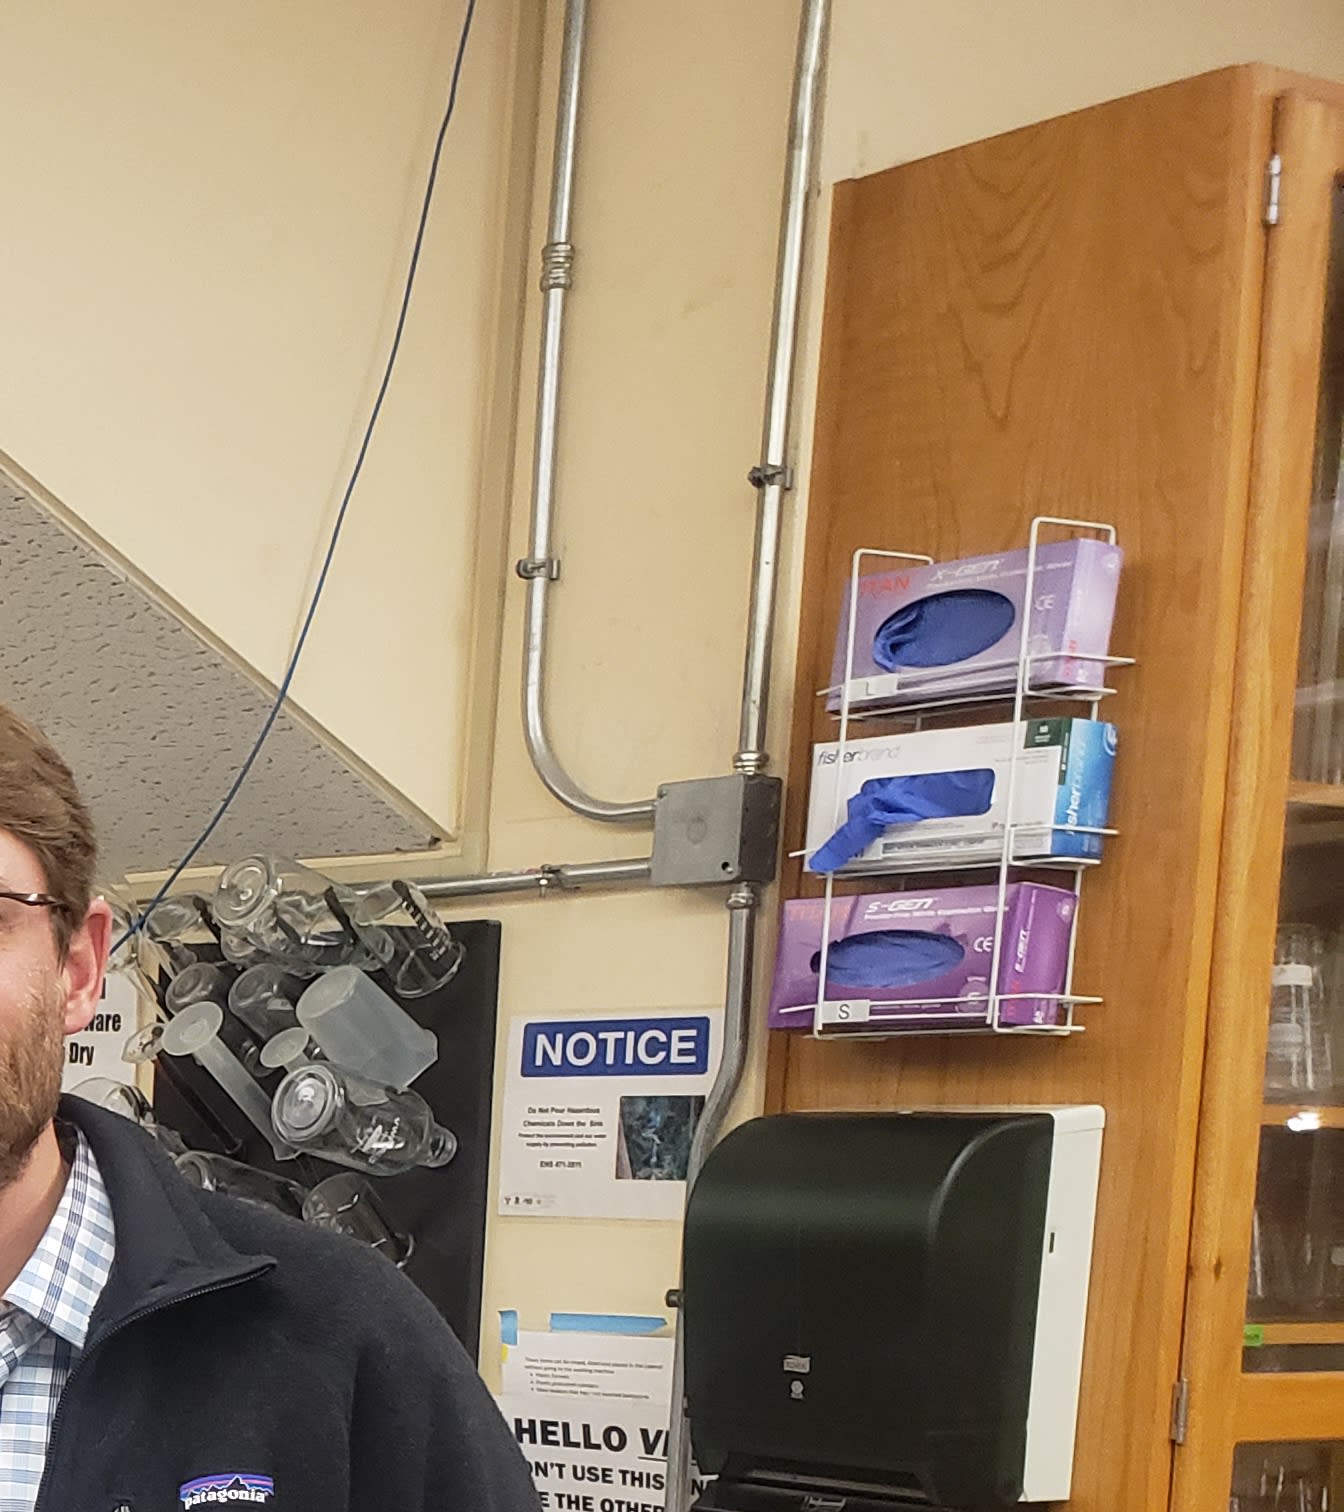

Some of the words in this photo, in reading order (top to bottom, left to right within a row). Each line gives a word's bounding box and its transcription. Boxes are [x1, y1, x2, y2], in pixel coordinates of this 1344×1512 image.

[838, 1004, 850, 1020] S
[69, 1042, 95, 1066] Dry
[535, 1029, 697, 1067] NOTICE
[514, 1418, 628, 1452] HELLO
[527, 1461, 566, 1479] N'T
[572, 1465, 614, 1484] USE
[619, 1469, 665, 1490] THIS
[184, 1488, 267, 1511] patagonia
[554, 1493, 594, 1512] THE
